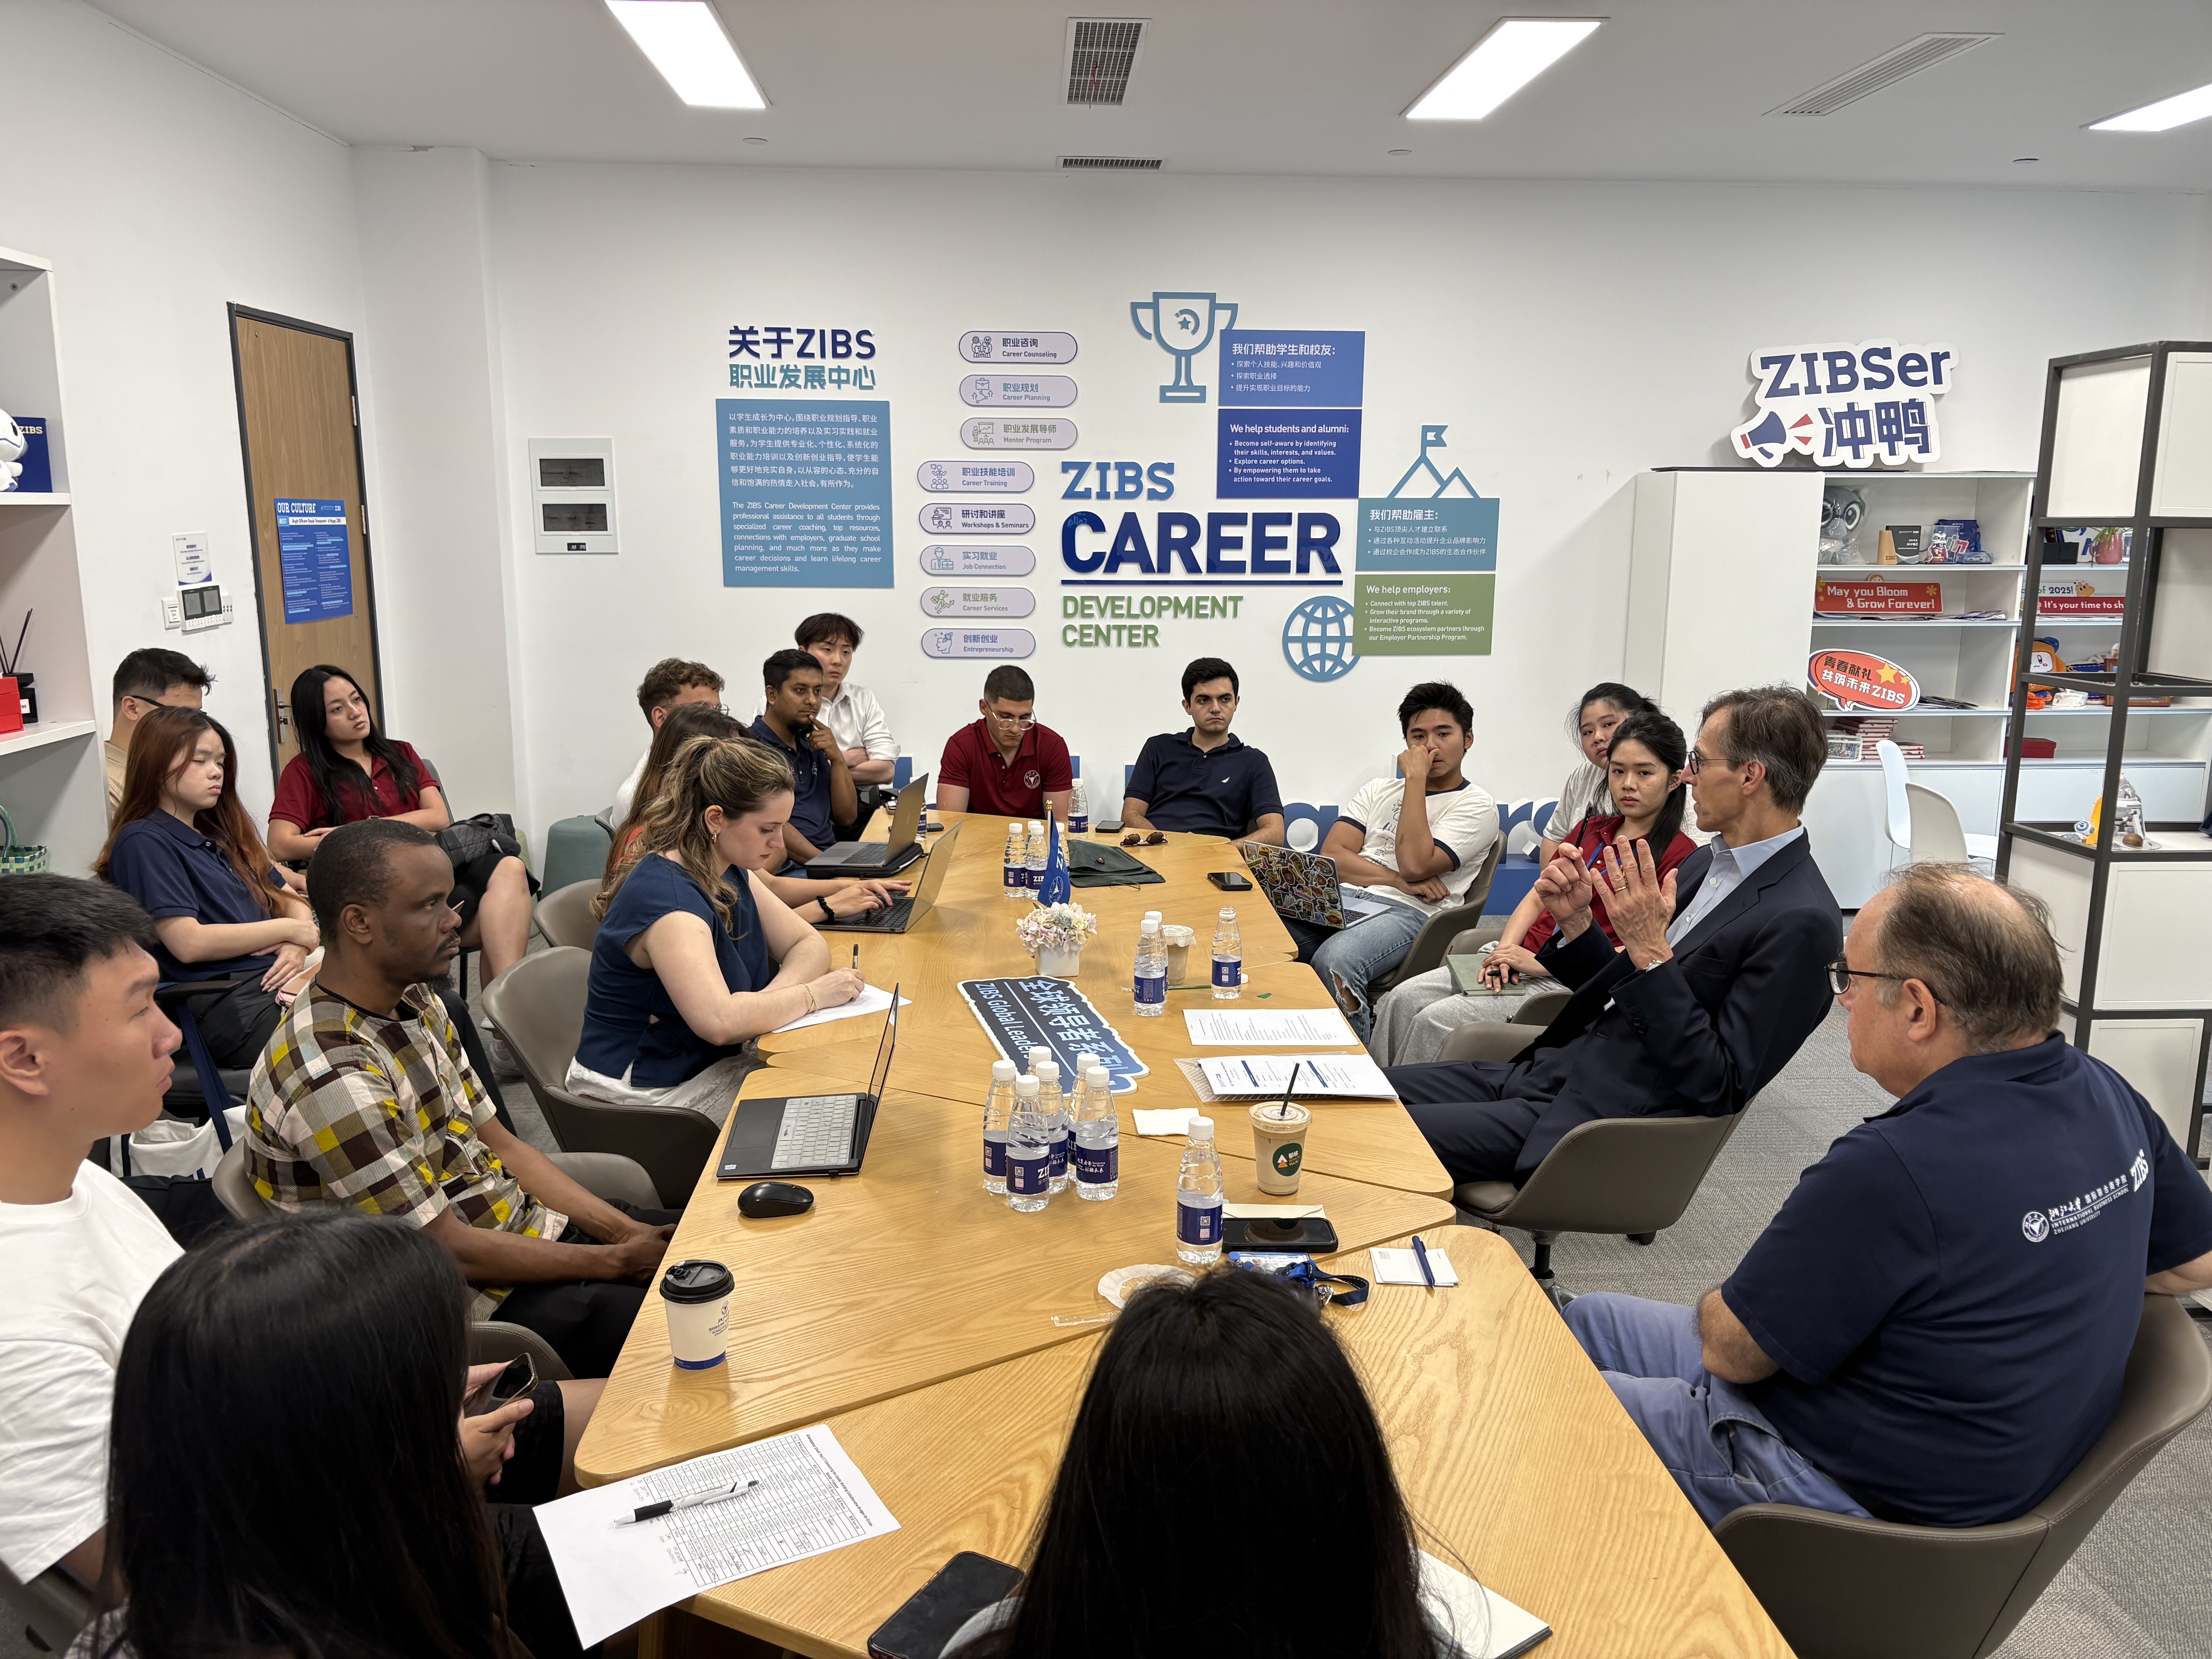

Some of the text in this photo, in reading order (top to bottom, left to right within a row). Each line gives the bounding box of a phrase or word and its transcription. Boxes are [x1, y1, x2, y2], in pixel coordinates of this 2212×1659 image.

[729, 326, 875, 359] 关于ZIBS
[1003, 338, 1038, 347] 职业咨询
[729, 364, 876, 390] 职业发展中心
[1760, 347, 1950, 398] ZIBSer
[1003, 383, 1038, 392] 职业规划
[1004, 424, 1056, 433] 职业发展导师
[1230, 424, 1349, 434] We help students and alumni:
[1817, 398, 1932, 460] 冲鸭
[962, 467, 1015, 477] 职业技能培训
[1061, 462, 1174, 501] ZIBS
[277, 502, 290, 513] OUR
[291, 503, 316, 514] CULTURE
[962, 510, 1005, 518] 研讨和讲座
[799, 524, 826, 532] coaching,
[1062, 511, 1341, 574] CAREER
[963, 551, 997, 560] 实习就业
[1382, 586, 1400, 595] help
[1403, 585, 1450, 595] employers:
[1827, 586, 1908, 598] May you Bloom
[963, 593, 997, 602] 就业服务
[1847, 598, 1935, 609] & Grow Forever!
[1063, 596, 1243, 619] DEVELOPMENT
[963, 635, 998, 643] 创新创业
[1063, 625, 1159, 647] CENTER
[1824, 656, 1872, 681] 青春献礼
[975, 983, 1002, 999] ZIBS
[987, 1000, 1024, 1025] Global
[2130, 1149, 2149, 1192] ZIBS
[2052, 1209, 2093, 1228] INTERNATIONAL
[2094, 1196, 2113, 1210] BUSINESS
[2113, 1187, 2129, 1200] SCHOOL
[2054, 1221, 2079, 1235] ZHEJIANG
[2080, 1211, 2100, 1225] UNIVERSITY
